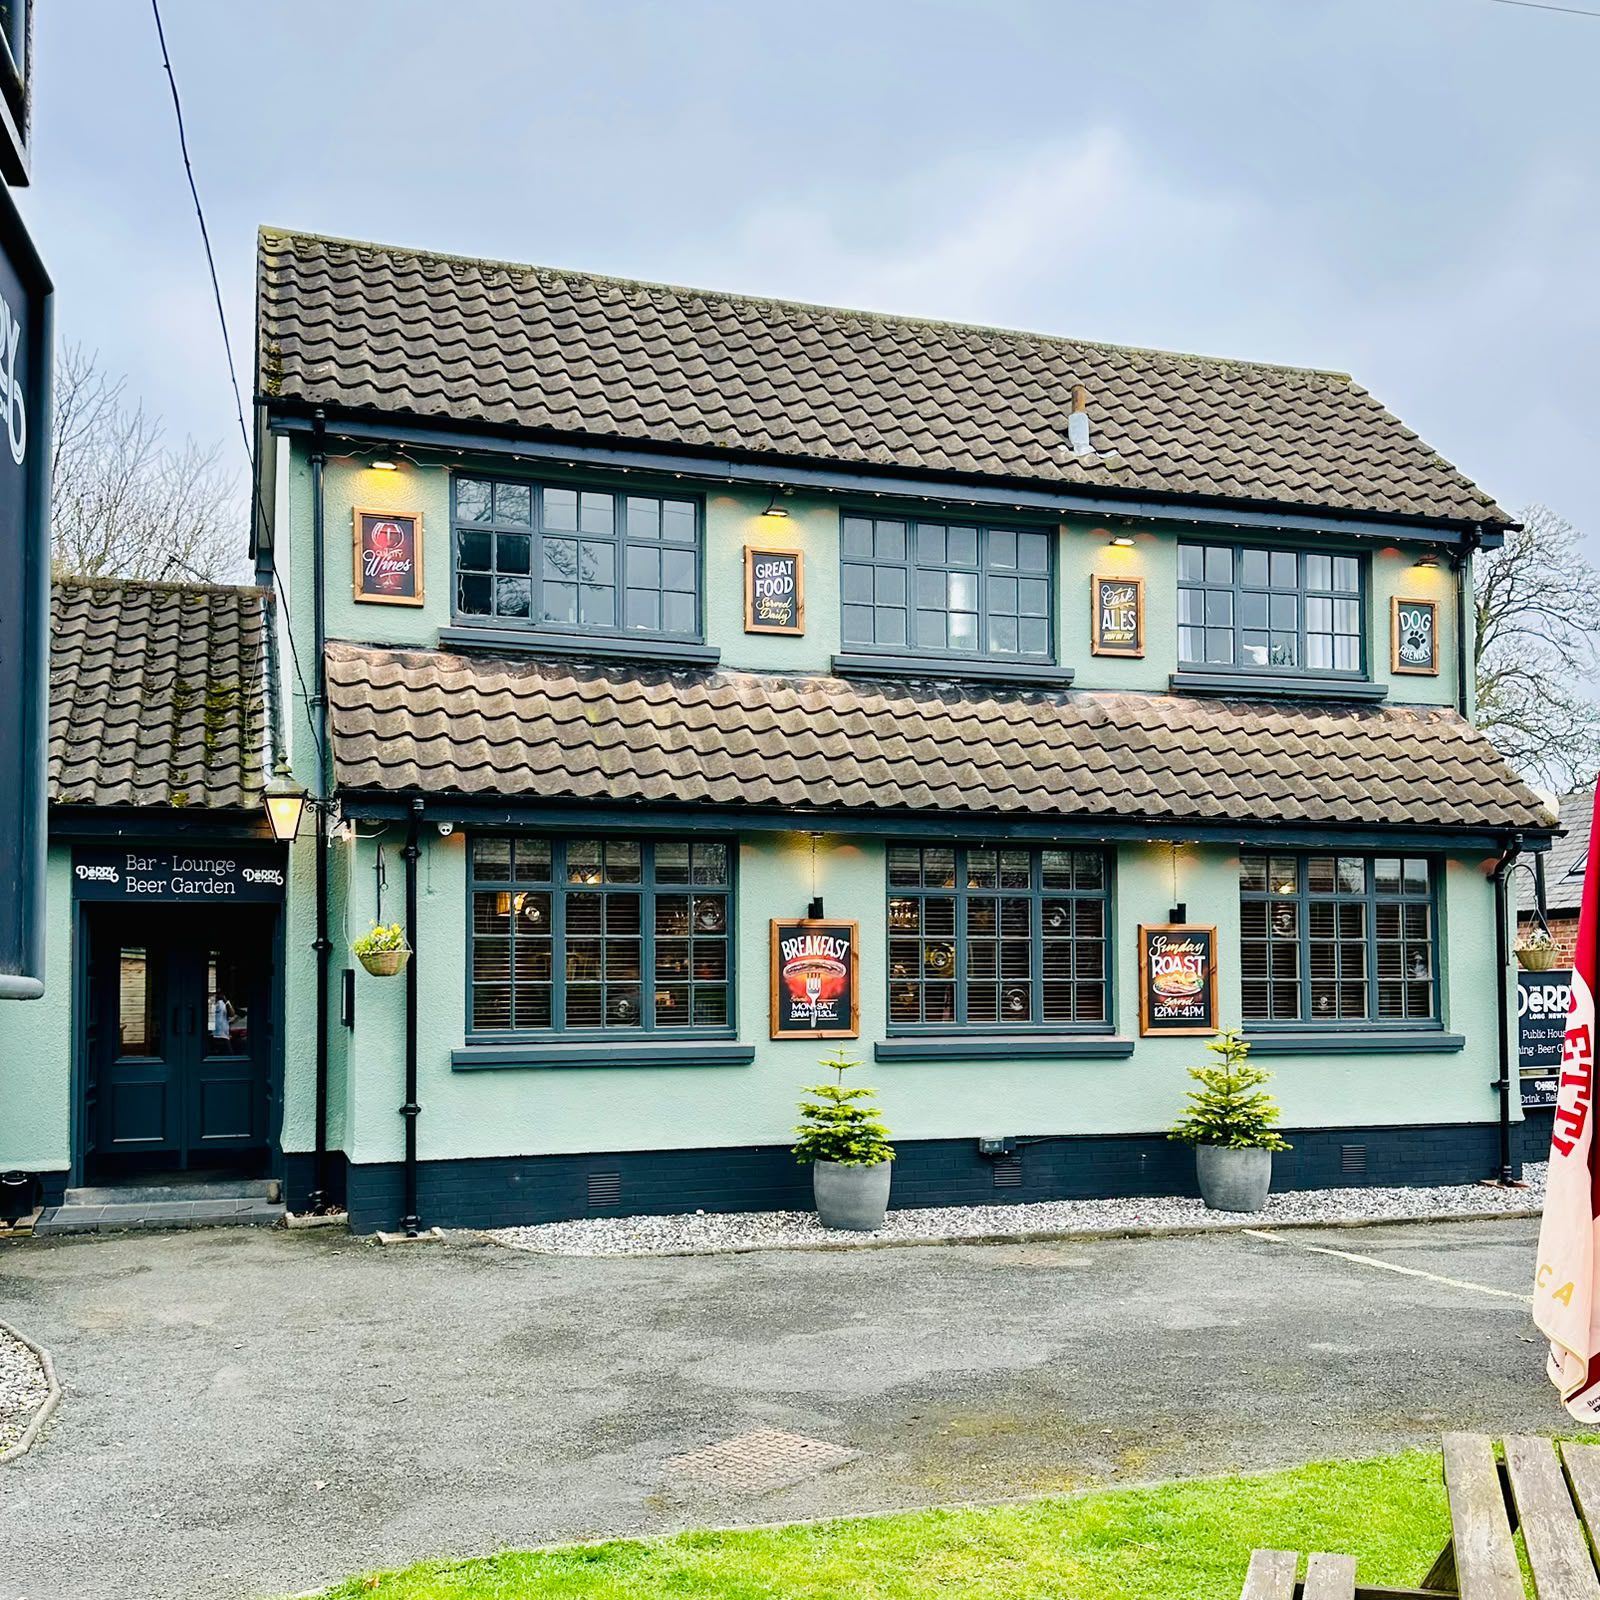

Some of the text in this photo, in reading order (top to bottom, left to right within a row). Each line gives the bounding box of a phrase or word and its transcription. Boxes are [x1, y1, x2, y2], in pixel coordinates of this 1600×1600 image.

[363, 549, 412, 576] Wines
[756, 561, 793, 578] GREAT
[756, 576, 794, 597] FOOD
[1101, 585, 1136, 606] Cask
[759, 608, 792, 625] Daily
[1102, 609, 1136, 631] ALES
[1399, 610, 1431, 631] DOG
[1399, 645, 1431, 660] FRIENDLY
[125, 854, 157, 871] Bar
[172, 855, 236, 876] Lounge
[125, 876, 236, 894] Beer Garden
[781, 935, 850, 961] BREAKFAST
[1148, 935, 1204, 957] Sunday
[1151, 956, 1206, 978] ROAST
[1522, 1029, 1546, 1039] Public
[1537, 1044, 1556, 1053] Beer
[1520, 1094, 1540, 1103] Drink
